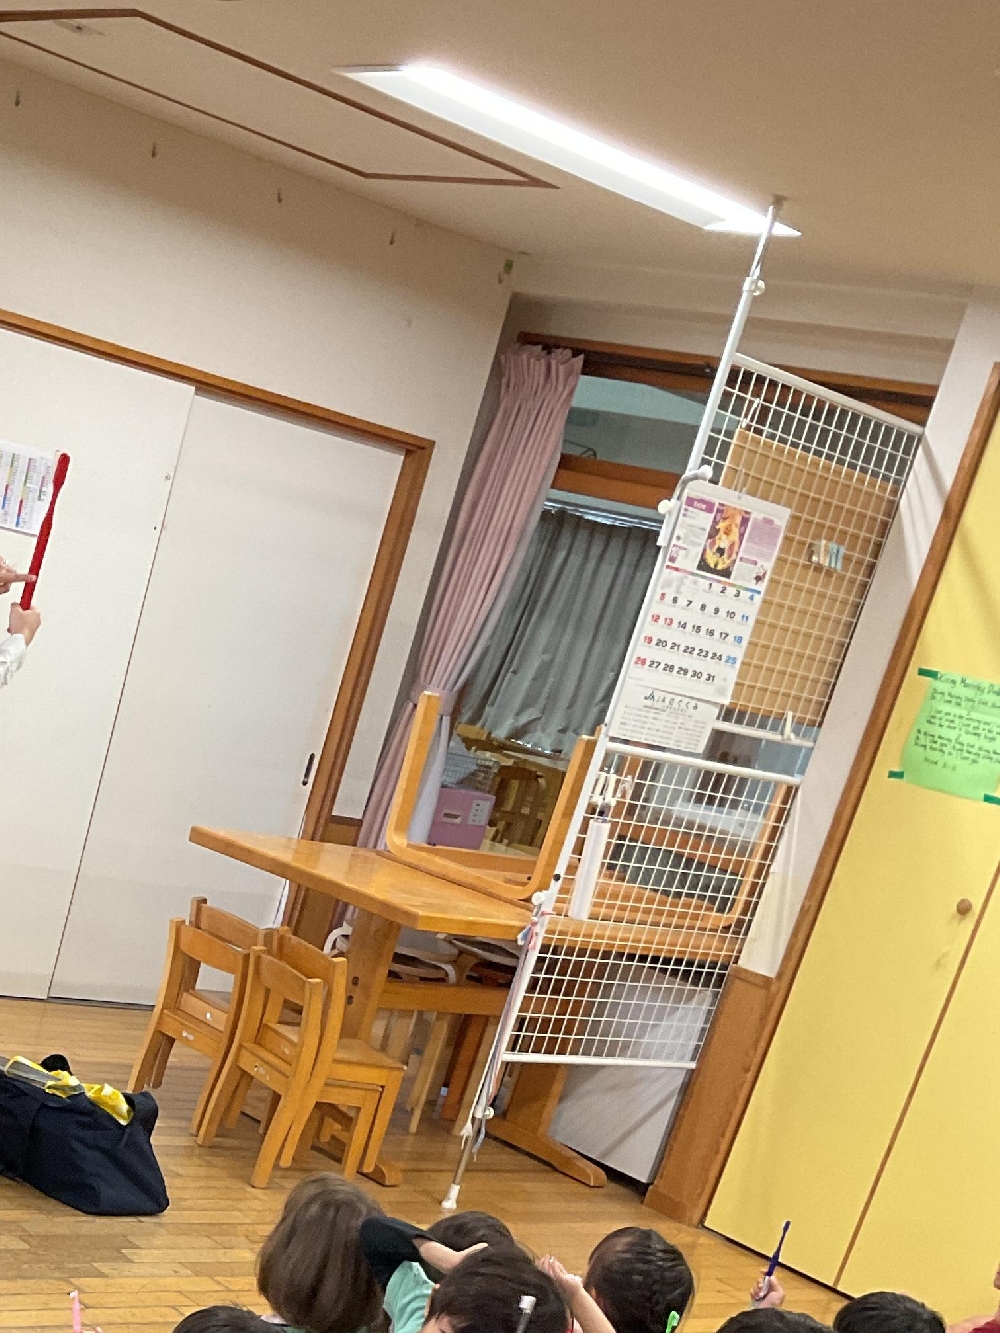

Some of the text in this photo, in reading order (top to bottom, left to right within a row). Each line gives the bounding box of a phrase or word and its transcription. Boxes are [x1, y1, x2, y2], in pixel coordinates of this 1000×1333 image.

[714, 607, 719, 615] 9
[726, 610, 736, 619] 10
[741, 614, 749, 622] 11
[651, 614, 743, 644] 12 13 14 15 16 17 18
[644, 636, 737, 664] 19 20 21 22 23 24 25
[634, 657, 715, 682] 26 27 28 29 30 31
